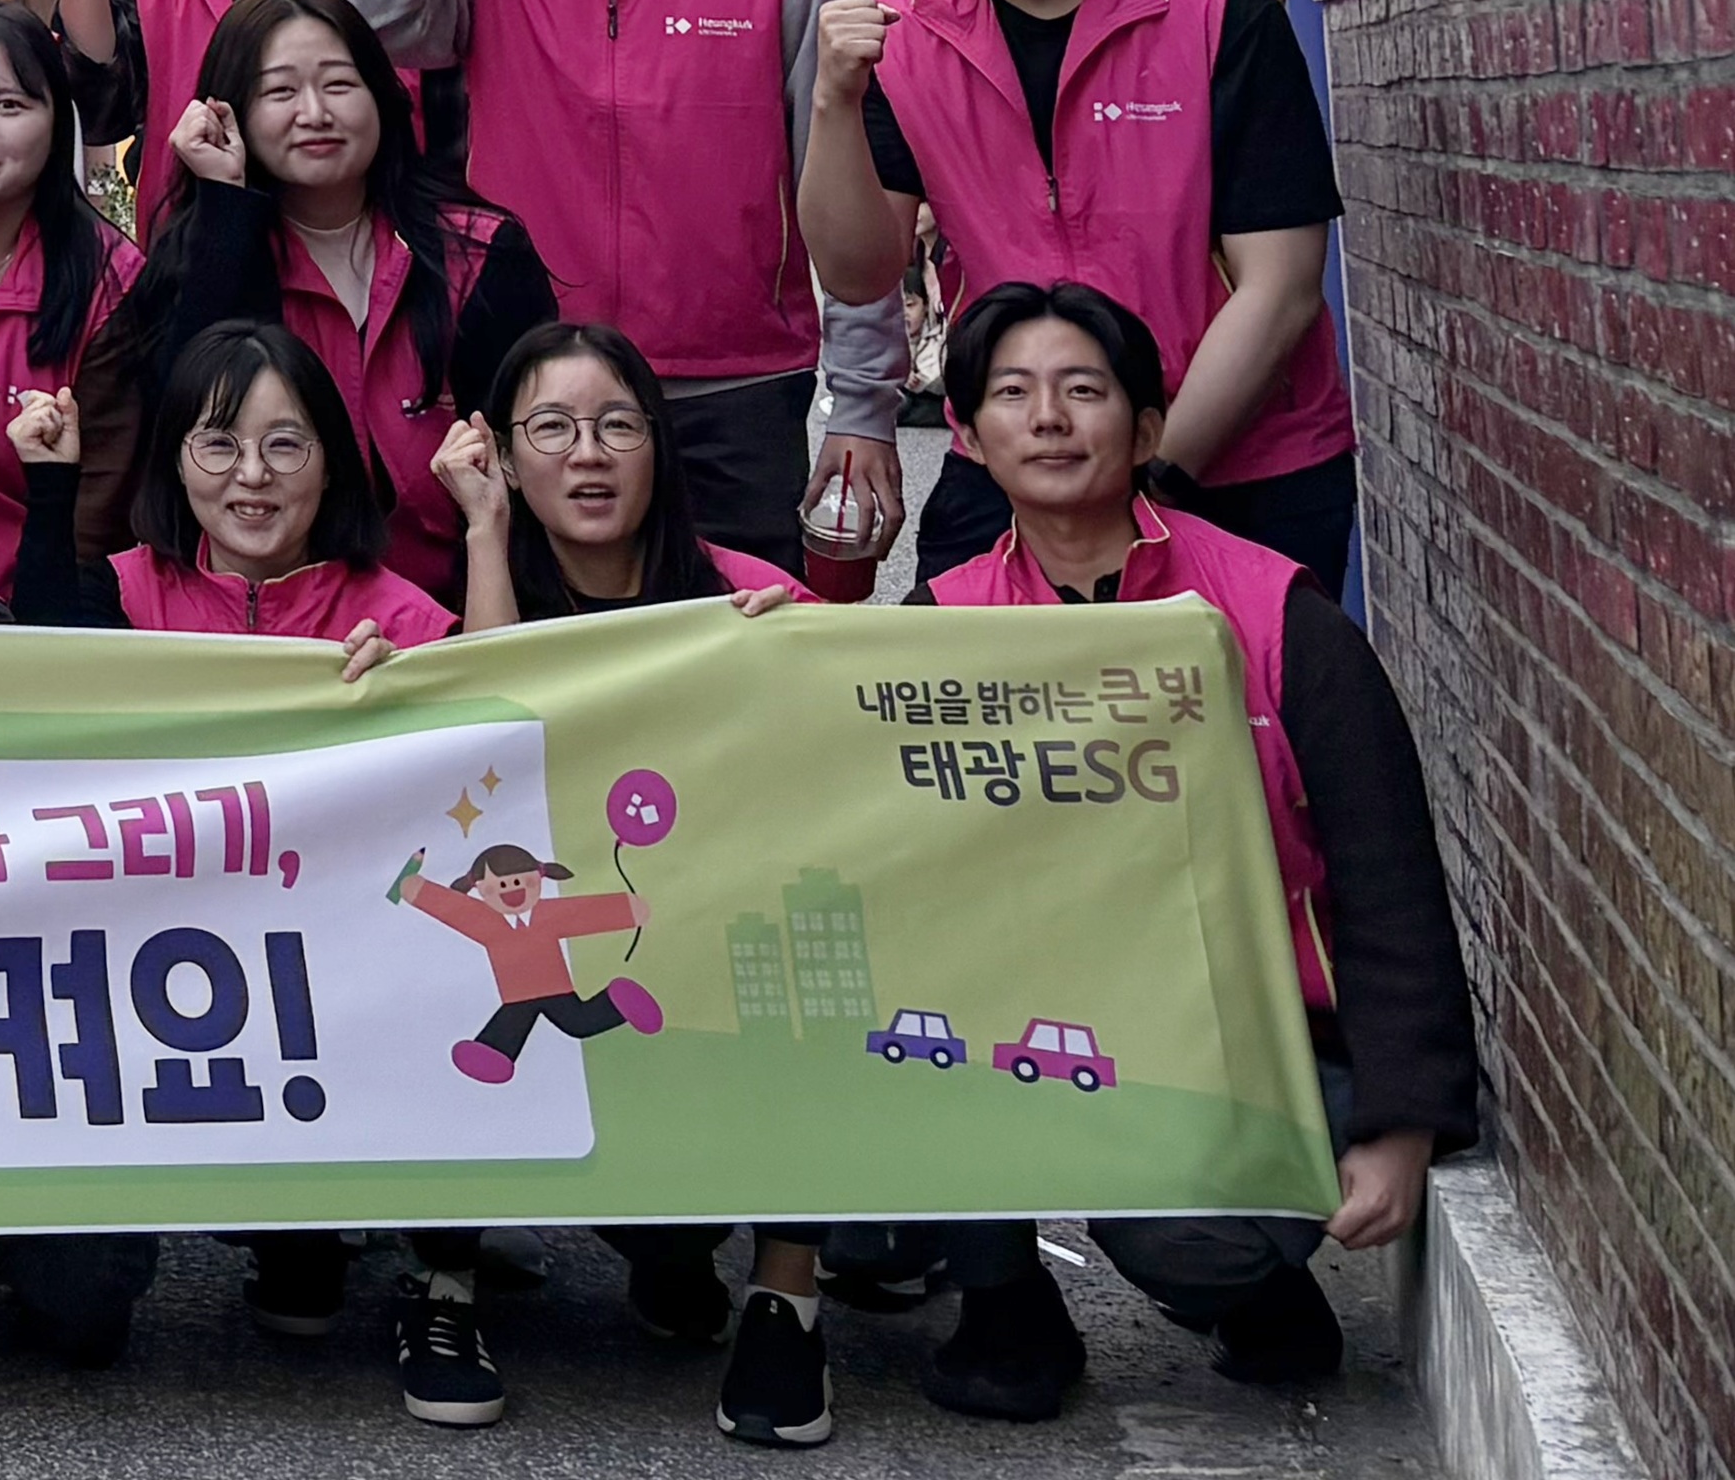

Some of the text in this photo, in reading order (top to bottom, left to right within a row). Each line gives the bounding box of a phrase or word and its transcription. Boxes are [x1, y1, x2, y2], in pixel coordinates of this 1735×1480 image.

[856, 665, 1206, 726] 내일을 밝히는 큰 빛
[899, 739, 1181, 807] 태광 ESG
[32, 780, 301, 891] 그리기,
